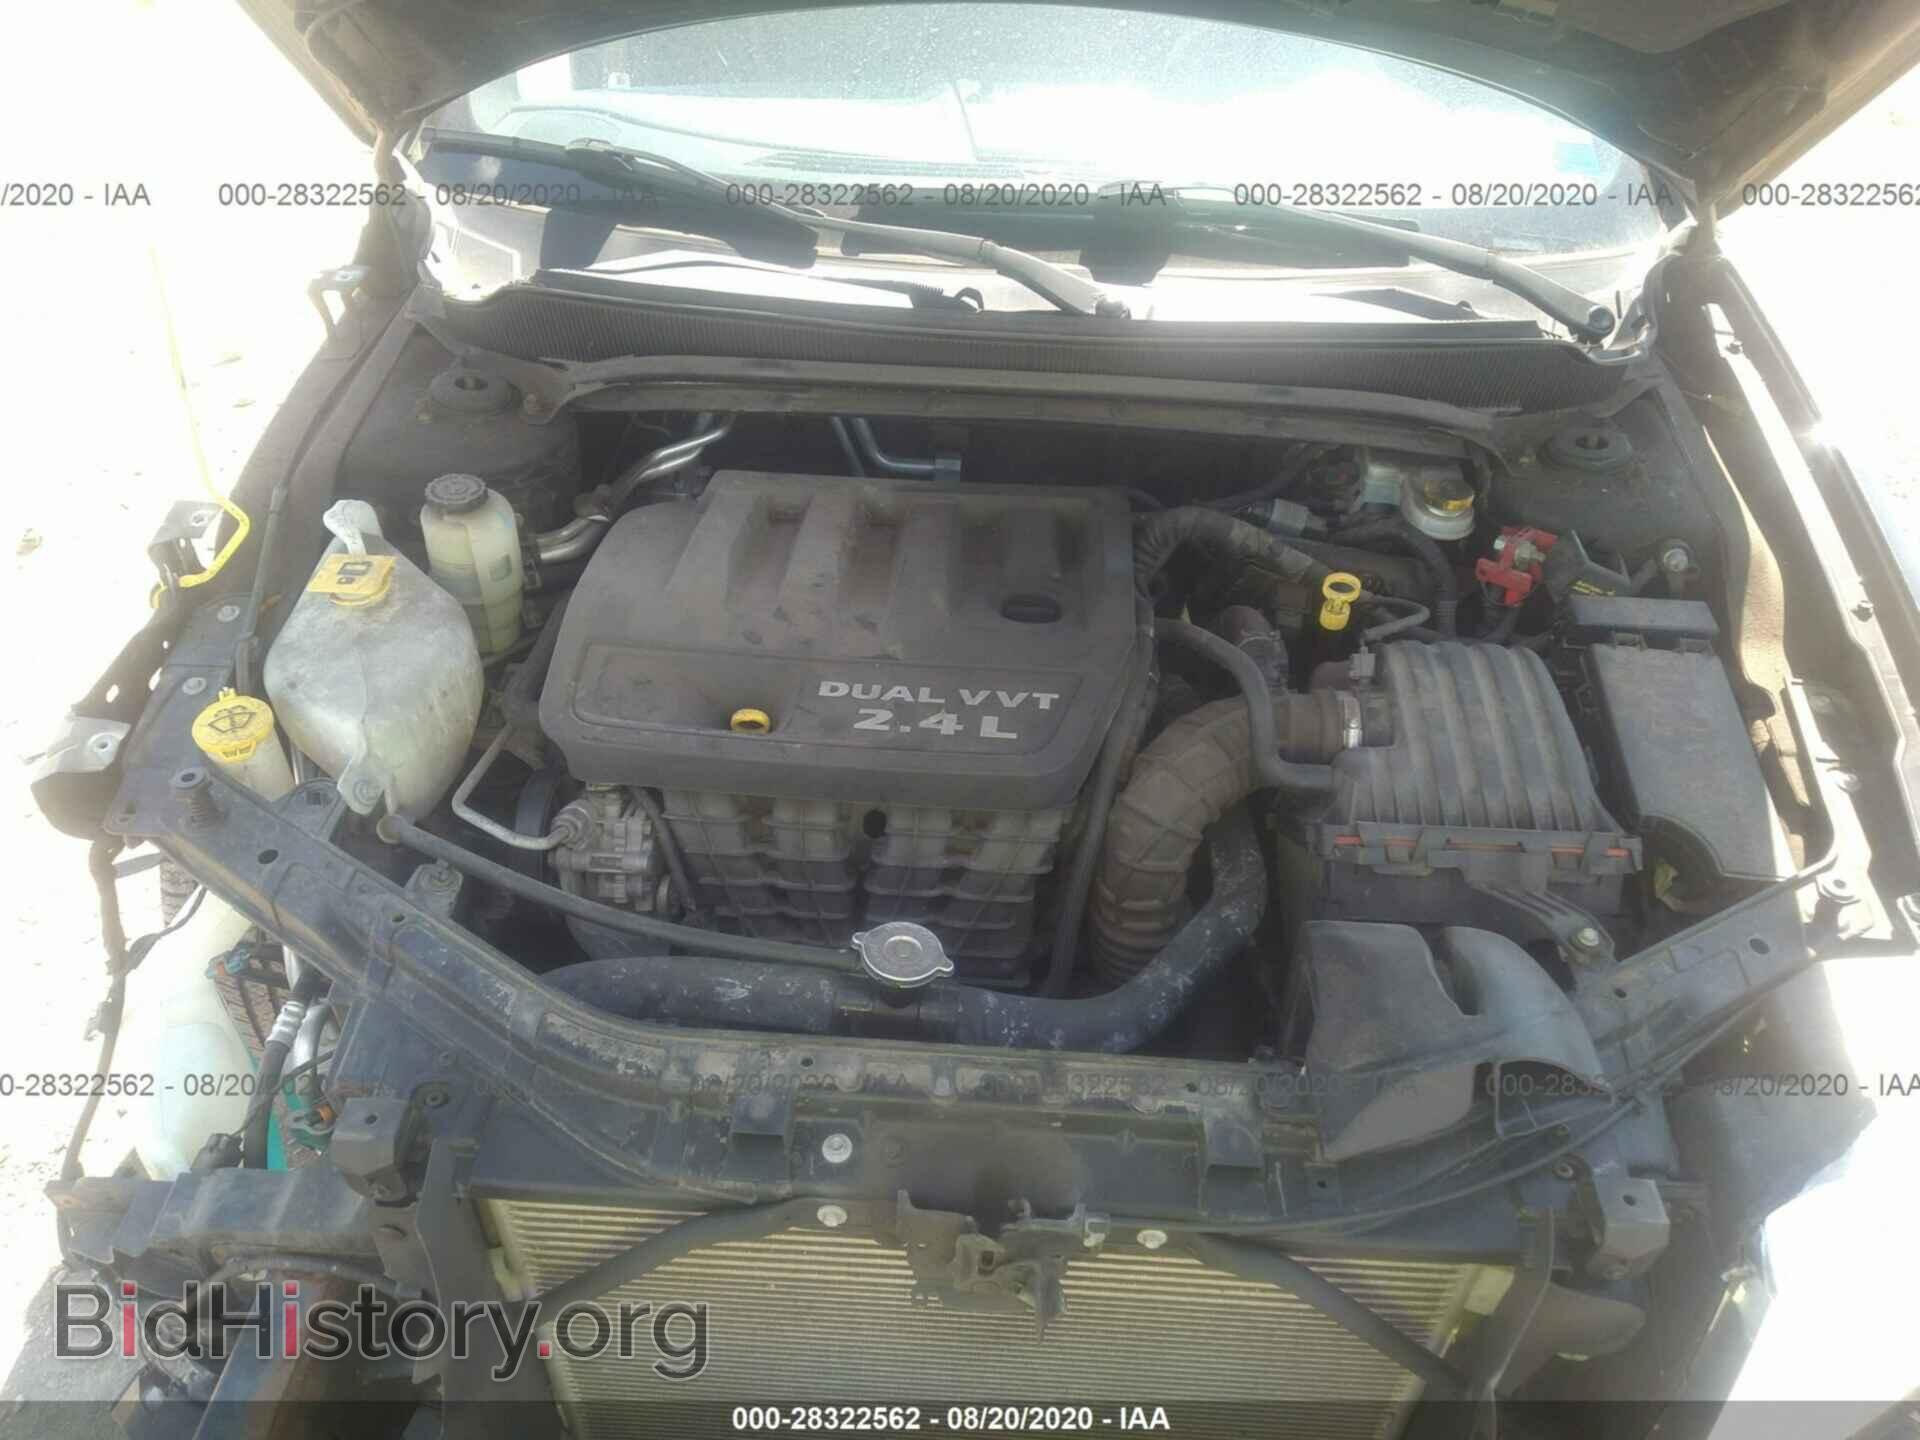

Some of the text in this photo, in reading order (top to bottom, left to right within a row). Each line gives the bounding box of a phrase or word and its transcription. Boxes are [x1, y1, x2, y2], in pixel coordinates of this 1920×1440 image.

[818, 680, 1060, 710] DUAL VVT
[853, 707, 1017, 739] 2.4 L
